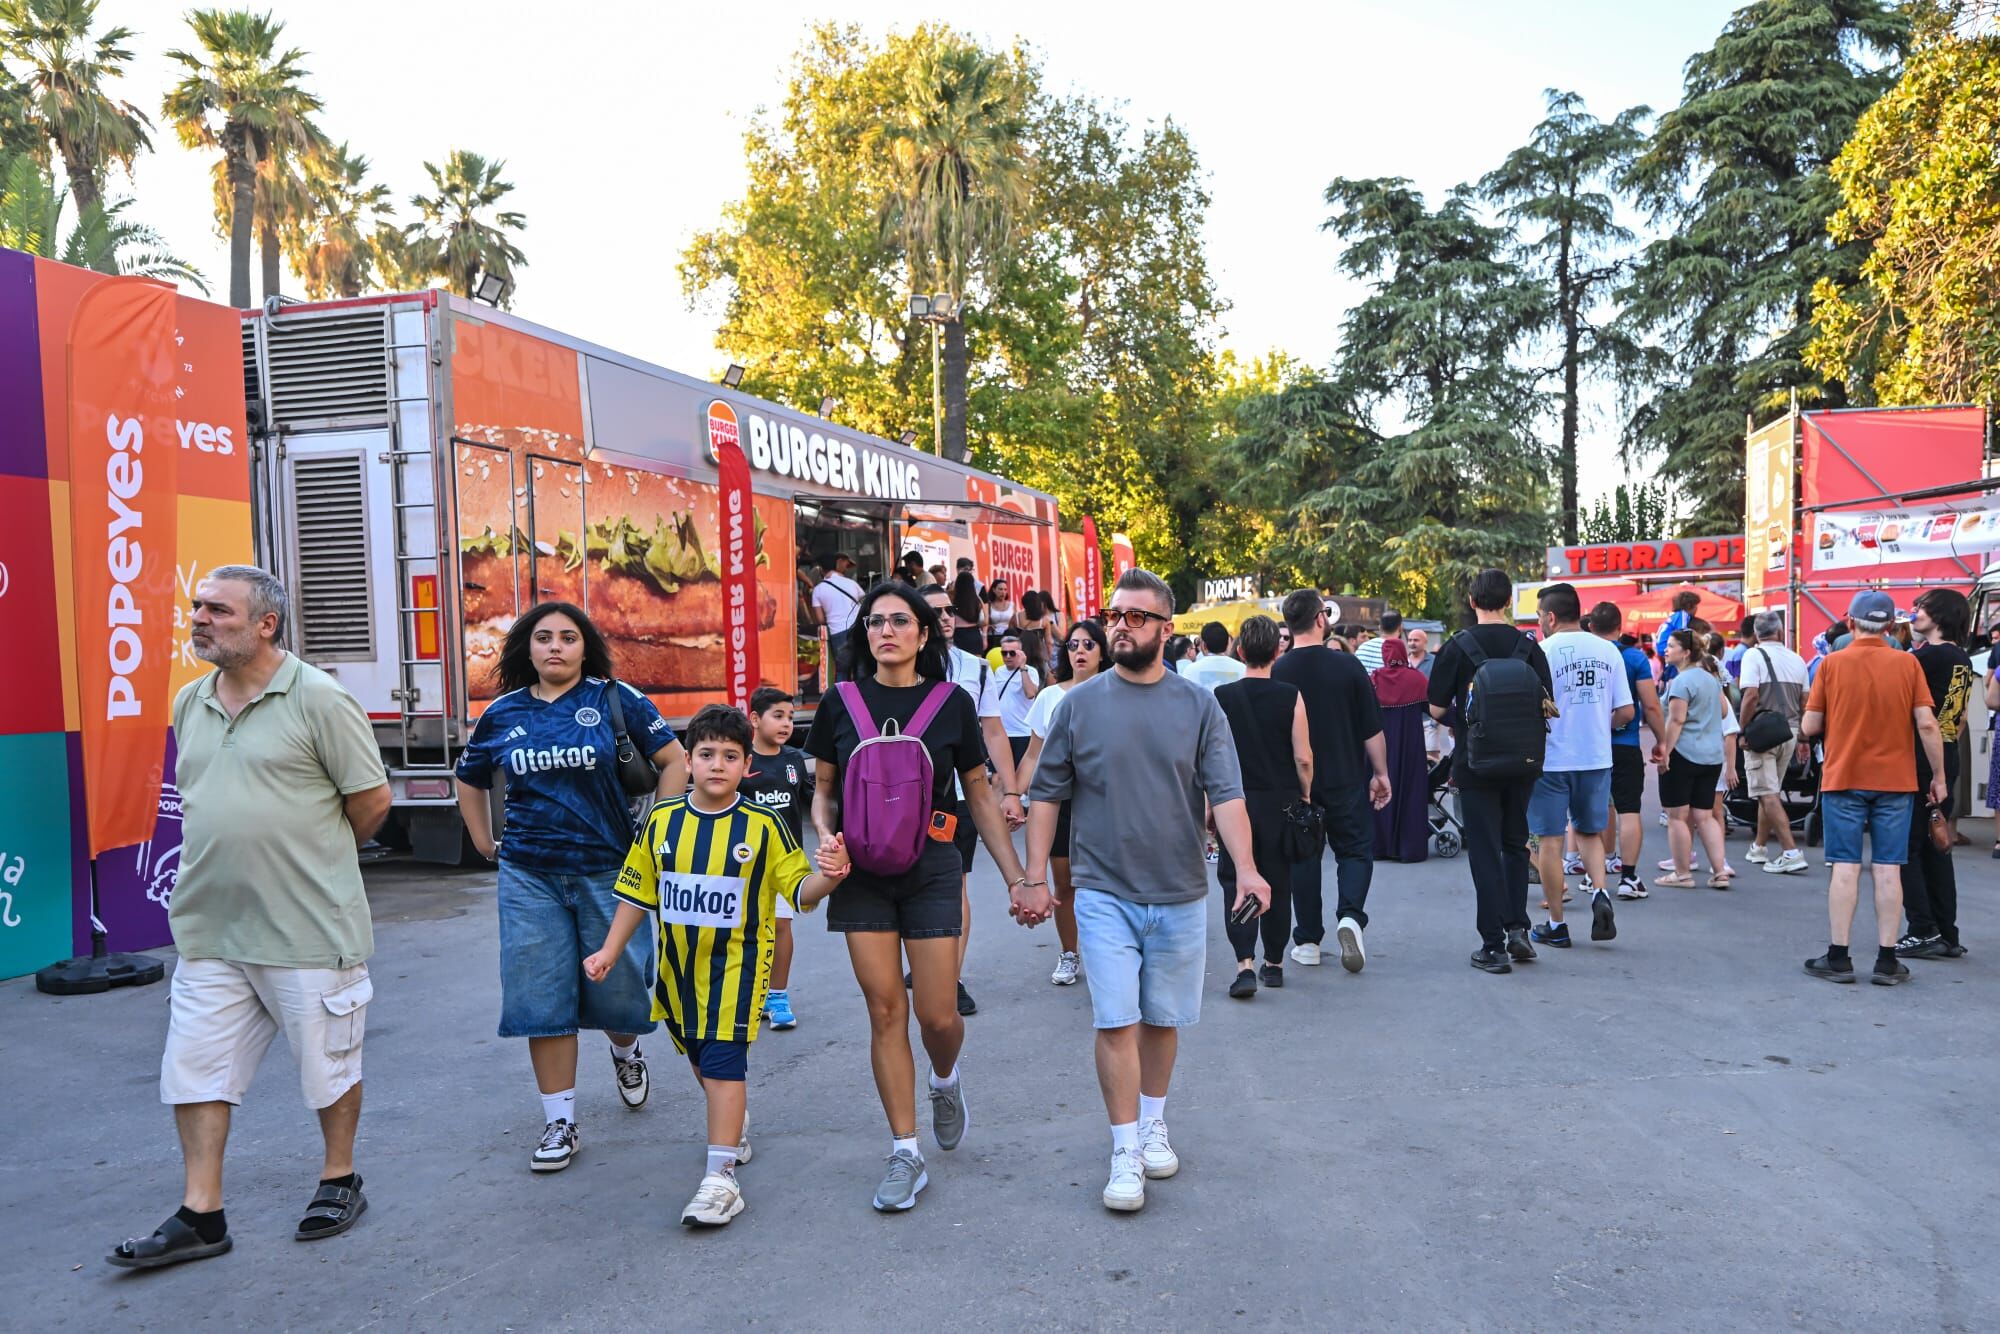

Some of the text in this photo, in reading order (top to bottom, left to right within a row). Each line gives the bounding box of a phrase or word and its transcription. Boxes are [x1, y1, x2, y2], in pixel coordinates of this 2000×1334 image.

[709, 418, 738, 437] BURGER
[749, 414, 921, 499] BURGER KING
[992, 540, 1034, 574] BURGER
[1564, 542, 1686, 574] TERRA
[1204, 576, 1253, 599] DÜRÜMLE
[1555, 661, 1582, 678] LIVING
[1576, 670, 1595, 687] 38
[511, 745, 597, 776] Otokoç
[755, 790, 791, 805] beko
[617, 876, 641, 890] DİNG
[664, 880, 737, 919] Otokoç
